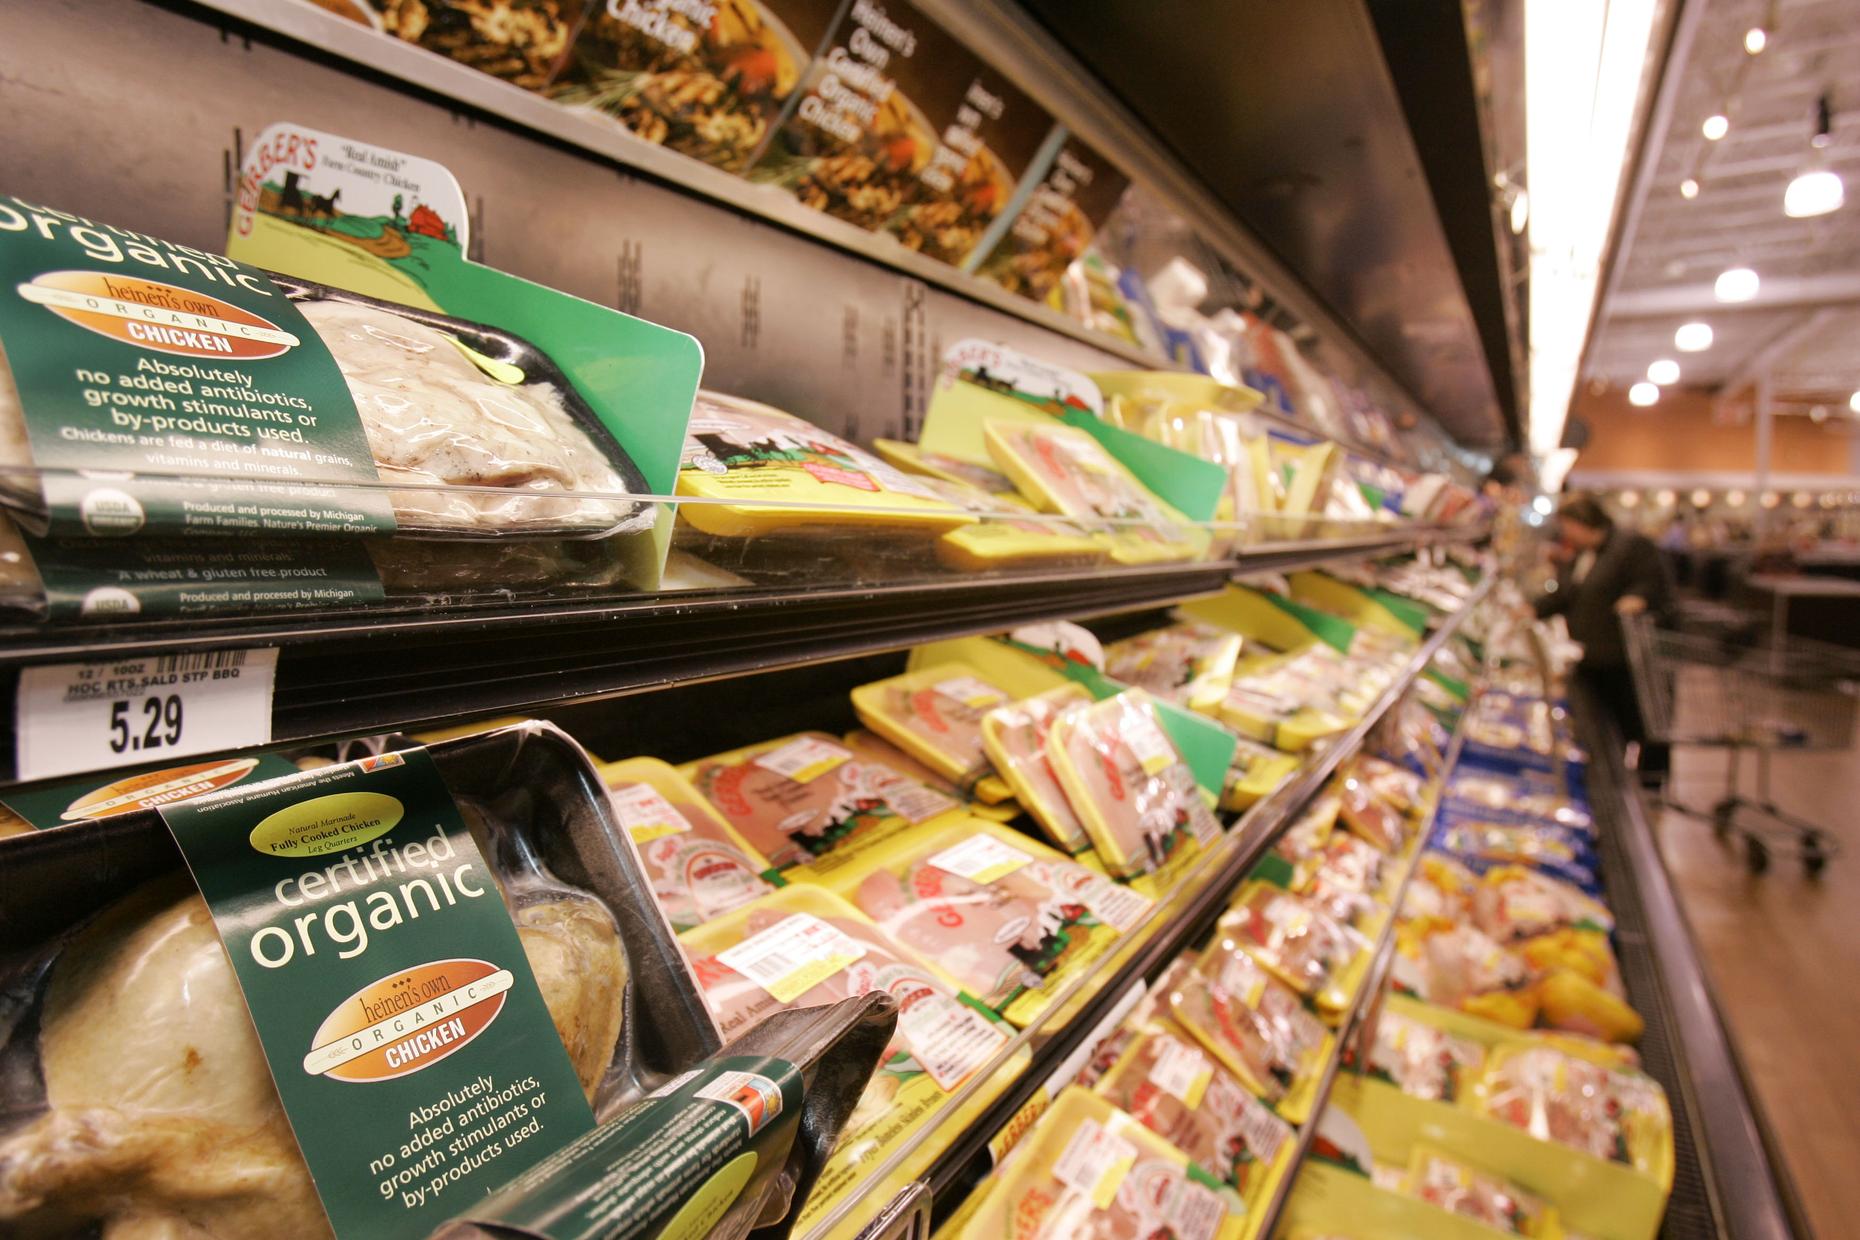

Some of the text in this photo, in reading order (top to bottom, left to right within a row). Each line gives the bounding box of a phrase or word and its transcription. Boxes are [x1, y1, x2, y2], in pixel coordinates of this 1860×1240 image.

[798, 95, 863, 145] Chicken
[237, 132, 318, 239] GERBER'S
[102, 277, 219, 318] heinen's own
[86, 298, 252, 337] ORGANIC
[127, 321, 233, 353] CHICKEN
[75, 368, 313, 411] no added antibiotics,
[137, 357, 253, 388] Absolutely
[83, 388, 319, 428] growth stimulants or
[110, 407, 310, 444] by-products used.
[60, 426, 136, 446] Chickens
[139, 435, 165, 448] are
[169, 434, 195, 450] fed
[211, 438, 240, 454] diet
[261, 444, 312, 462] natural
[314, 452, 354, 469] grains,
[146, 452, 210, 470] vitamins
[213, 456, 241, 472] and
[183, 500, 366, 525] Produced and processed by Michigan
[184, 513, 221, 527] Farm
[263, 517, 304, 531] Nature's
[305, 519, 341, 533] Premier
[203, 567, 249, 583] gluten
[179, 588, 355, 605] Produced and processed by Michigan
[67, 681, 102, 695] HOC
[181, 670, 210, 683] STP
[212, 667, 241, 681] BBQ
[109, 693, 184, 754] 5.29
[138, 781, 215, 809] CHICKEN
[245, 789, 280, 802] Humane
[280, 780, 317, 793] American
[317, 776, 330, 784] the
[196, 797, 244, 813] Association
[288, 813, 356, 835] Natural Marinade
[270, 818, 381, 853] Fully Cooked Chicken
[307, 836, 358, 854] Leg Quarters
[275, 823, 456, 907] certified
[250, 860, 485, 969] organic
[359, 974, 452, 1024] heinen's own
[351, 986, 478, 1051] ORGANIC
[385, 1017, 466, 1069] CHICKEN
[409, 1075, 493, 1129] Absolutely
[369, 1075, 541, 1175] no added antibiotics,
[380, 1092, 547, 1200] growth stimulants or
[402, 1142, 502, 1208] by-products
[504, 1116, 545, 1148] used.
